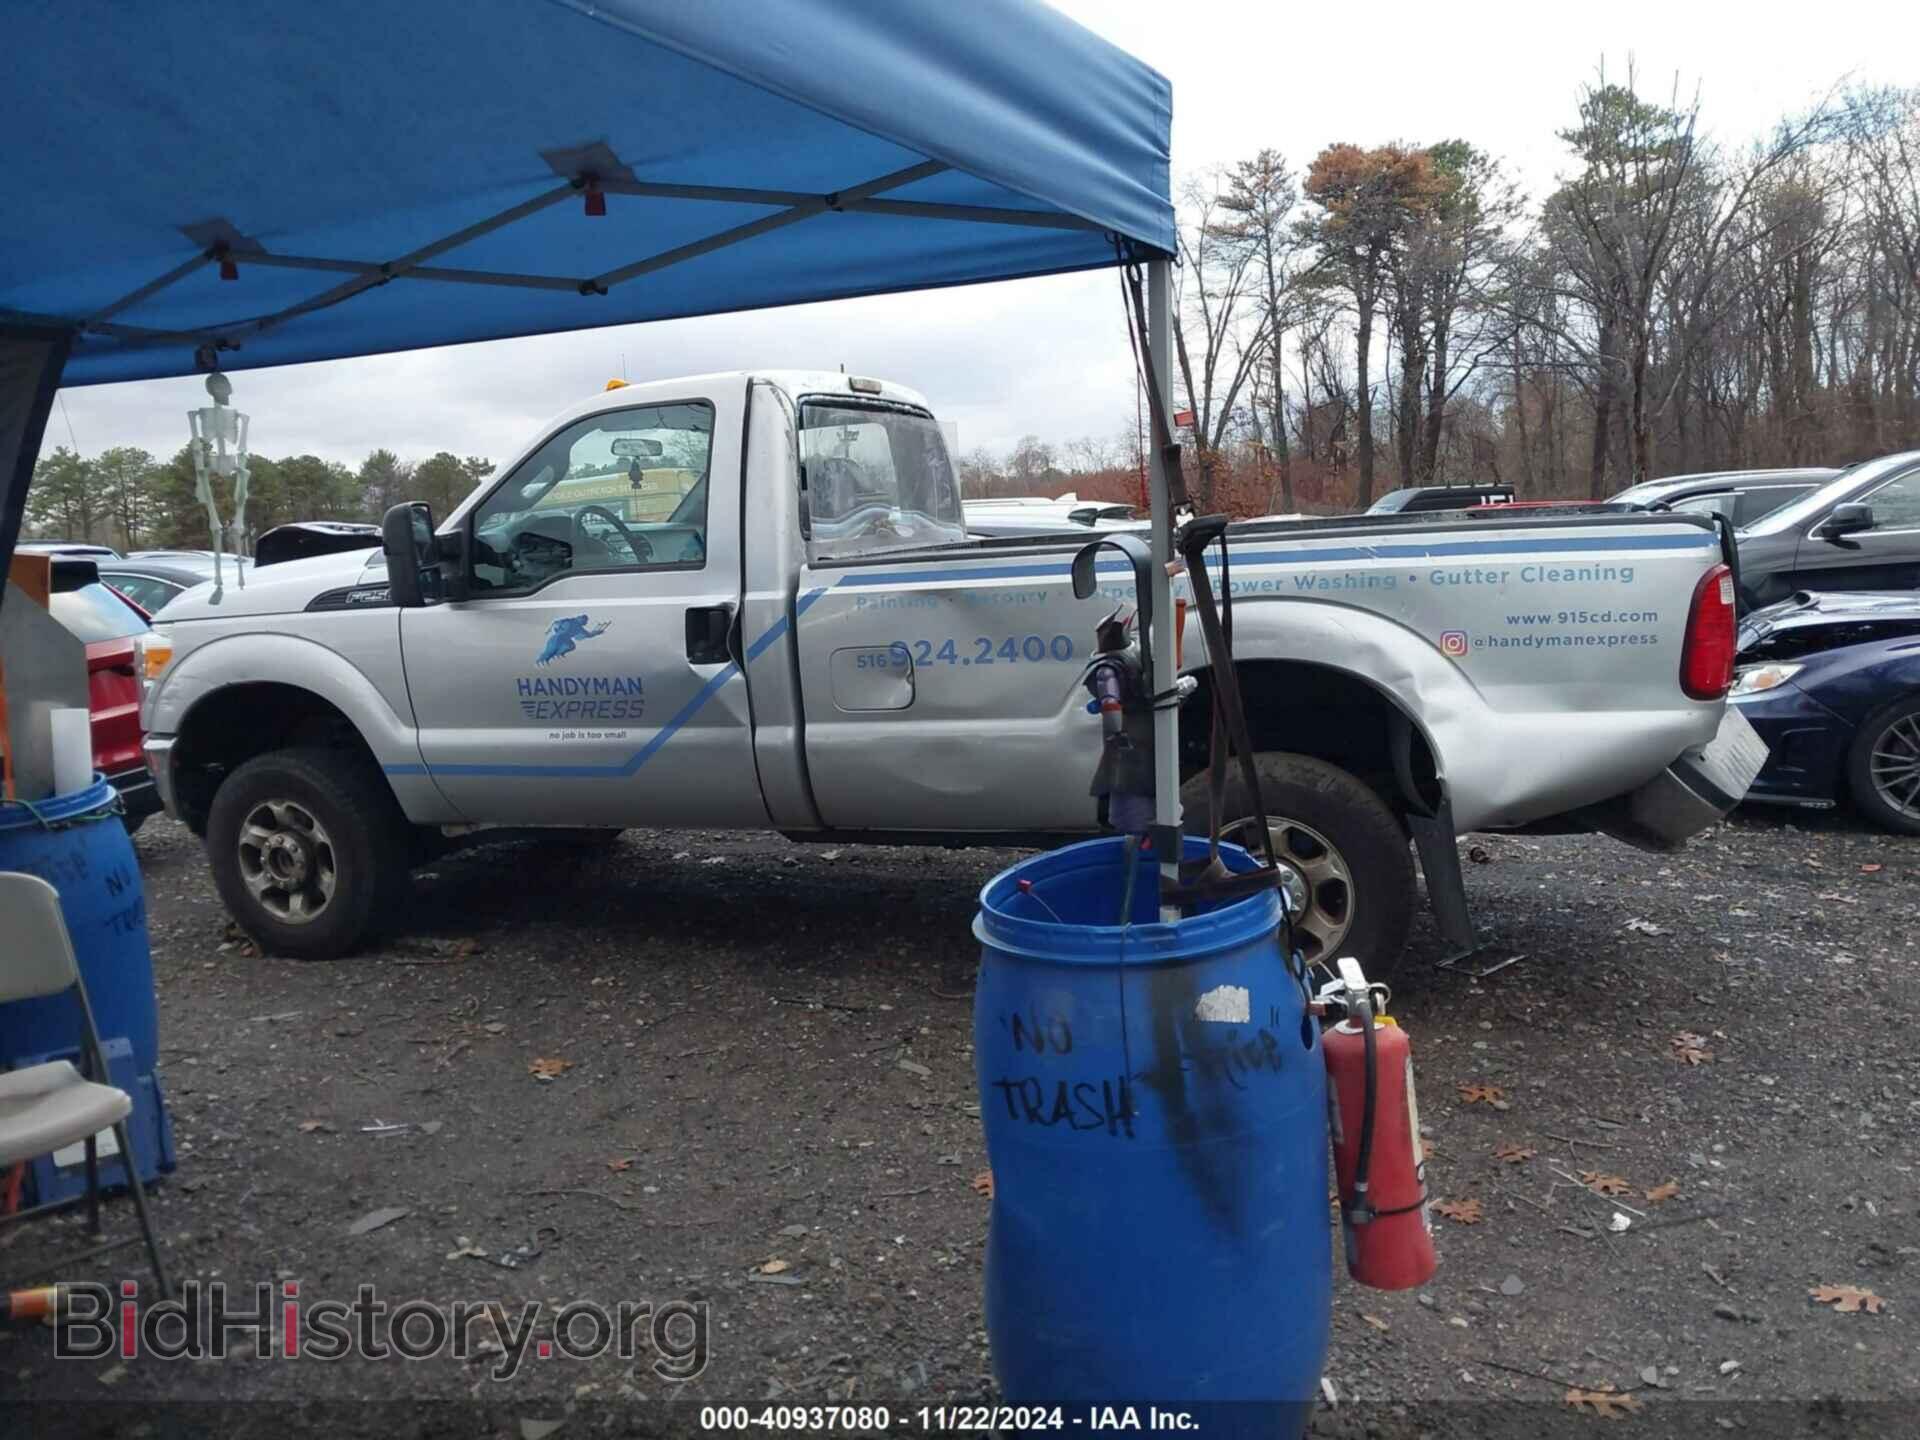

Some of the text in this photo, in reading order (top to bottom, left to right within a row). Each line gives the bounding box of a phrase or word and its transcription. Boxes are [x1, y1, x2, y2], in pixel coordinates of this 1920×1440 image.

[1294, 572, 1397, 592] Washing
[1429, 570, 1510, 585] Gutter
[1520, 564, 1634, 583] Cleaning
[1506, 610, 1658, 625] www915cd.com
[1474, 633, 1658, 649] @handymanexpress
[857, 655, 886, 669] 516
[516, 677, 643, 697] HANDYMAN
[535, 700, 645, 719] EXPRESS
[991, 1076, 1135, 1138] TRASH
